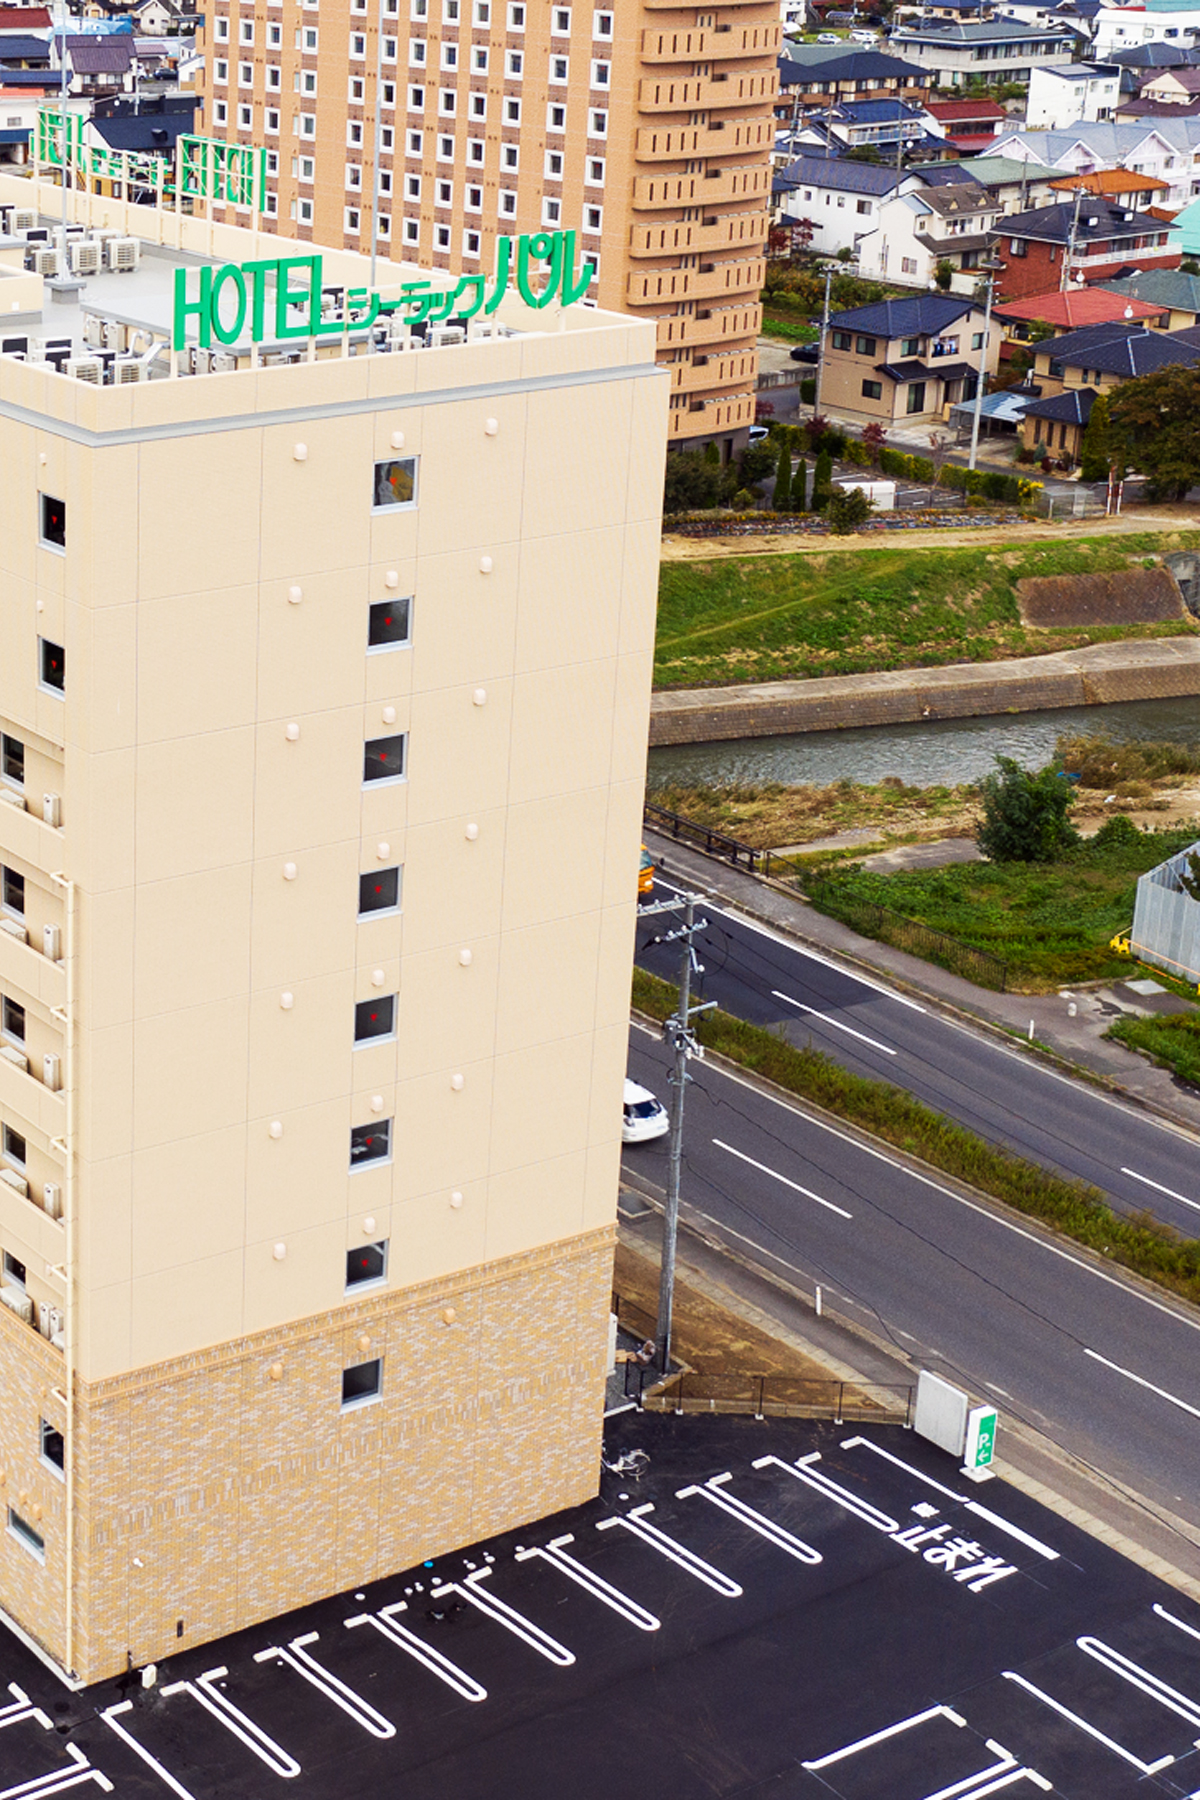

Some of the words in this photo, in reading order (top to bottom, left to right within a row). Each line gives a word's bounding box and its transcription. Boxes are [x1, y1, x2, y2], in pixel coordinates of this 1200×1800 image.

[174, 255, 346, 351] HOTEL
[888, 1523, 1019, 1593] 止まれ
